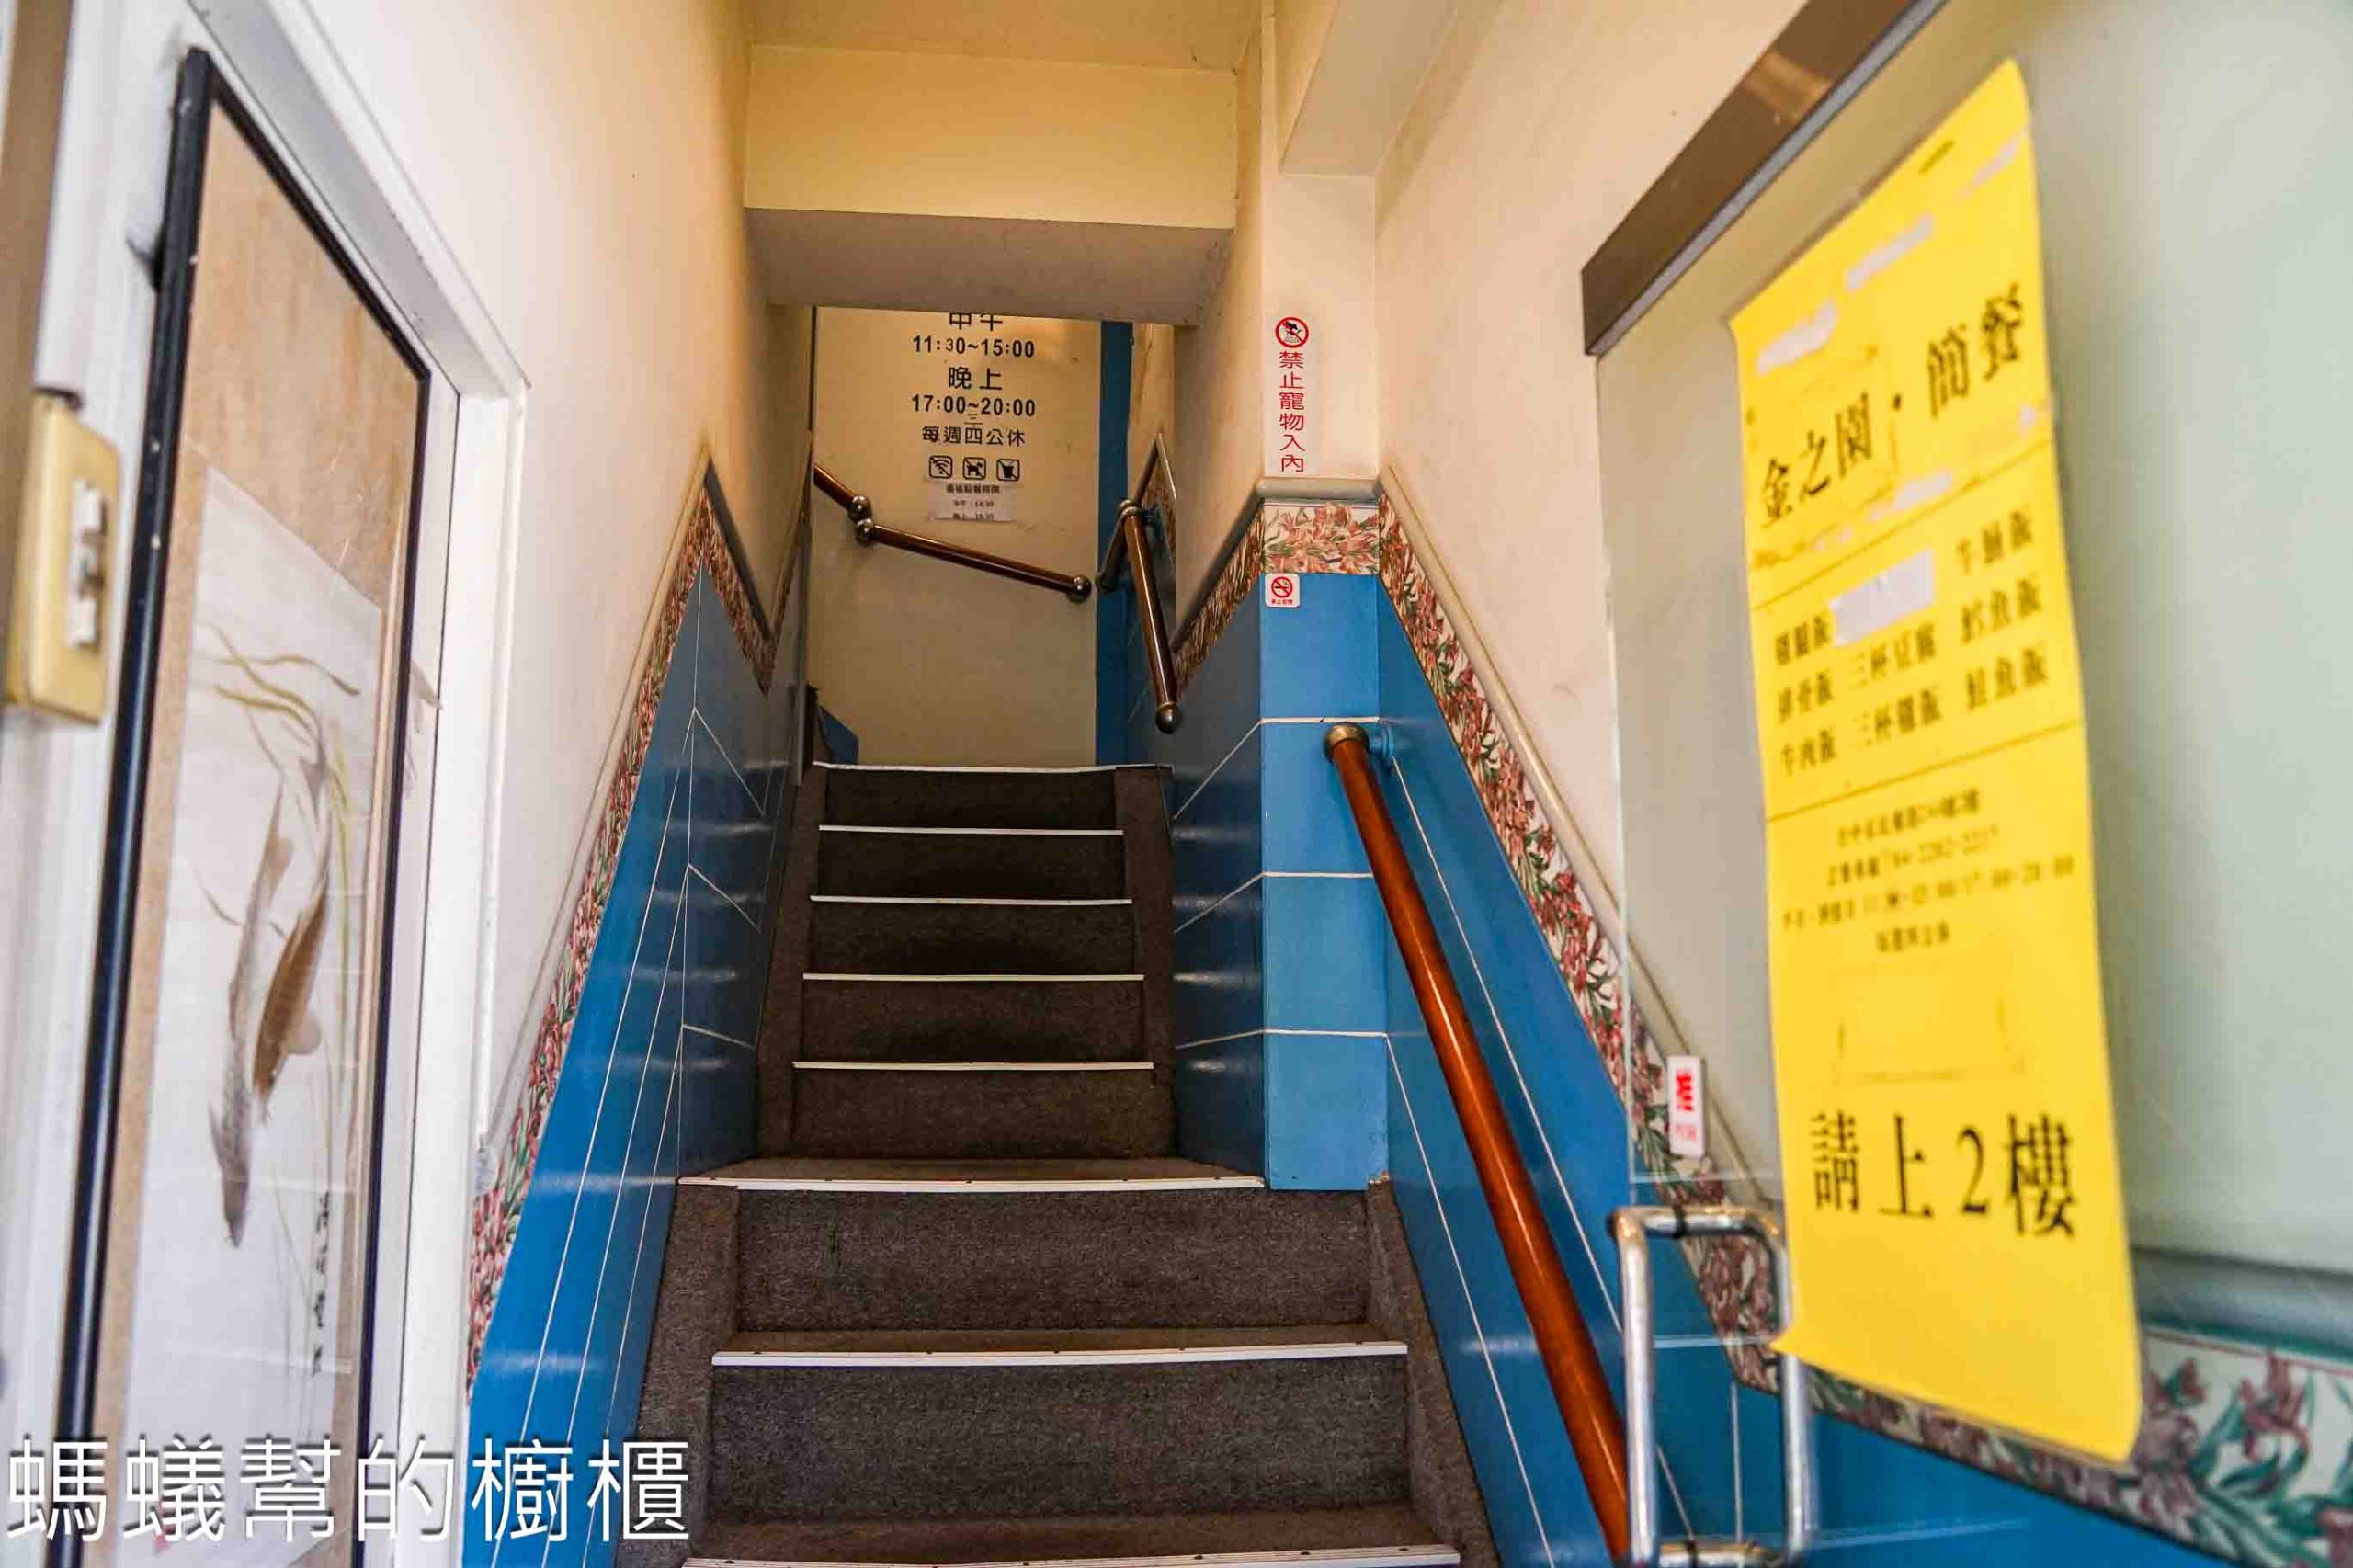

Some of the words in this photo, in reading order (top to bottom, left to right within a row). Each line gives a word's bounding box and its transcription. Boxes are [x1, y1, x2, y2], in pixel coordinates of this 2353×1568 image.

[913, 335, 1034, 358] 11:30~15:00
[949, 366, 1003, 391] 晚上
[912, 394, 1035, 416] 17:00~20:00
[1279, 351, 1305, 472] 禁止寵物入內
[922, 426, 1026, 447] 每週四公休
[1811, 1110, 2076, 1237] 請上2樓
